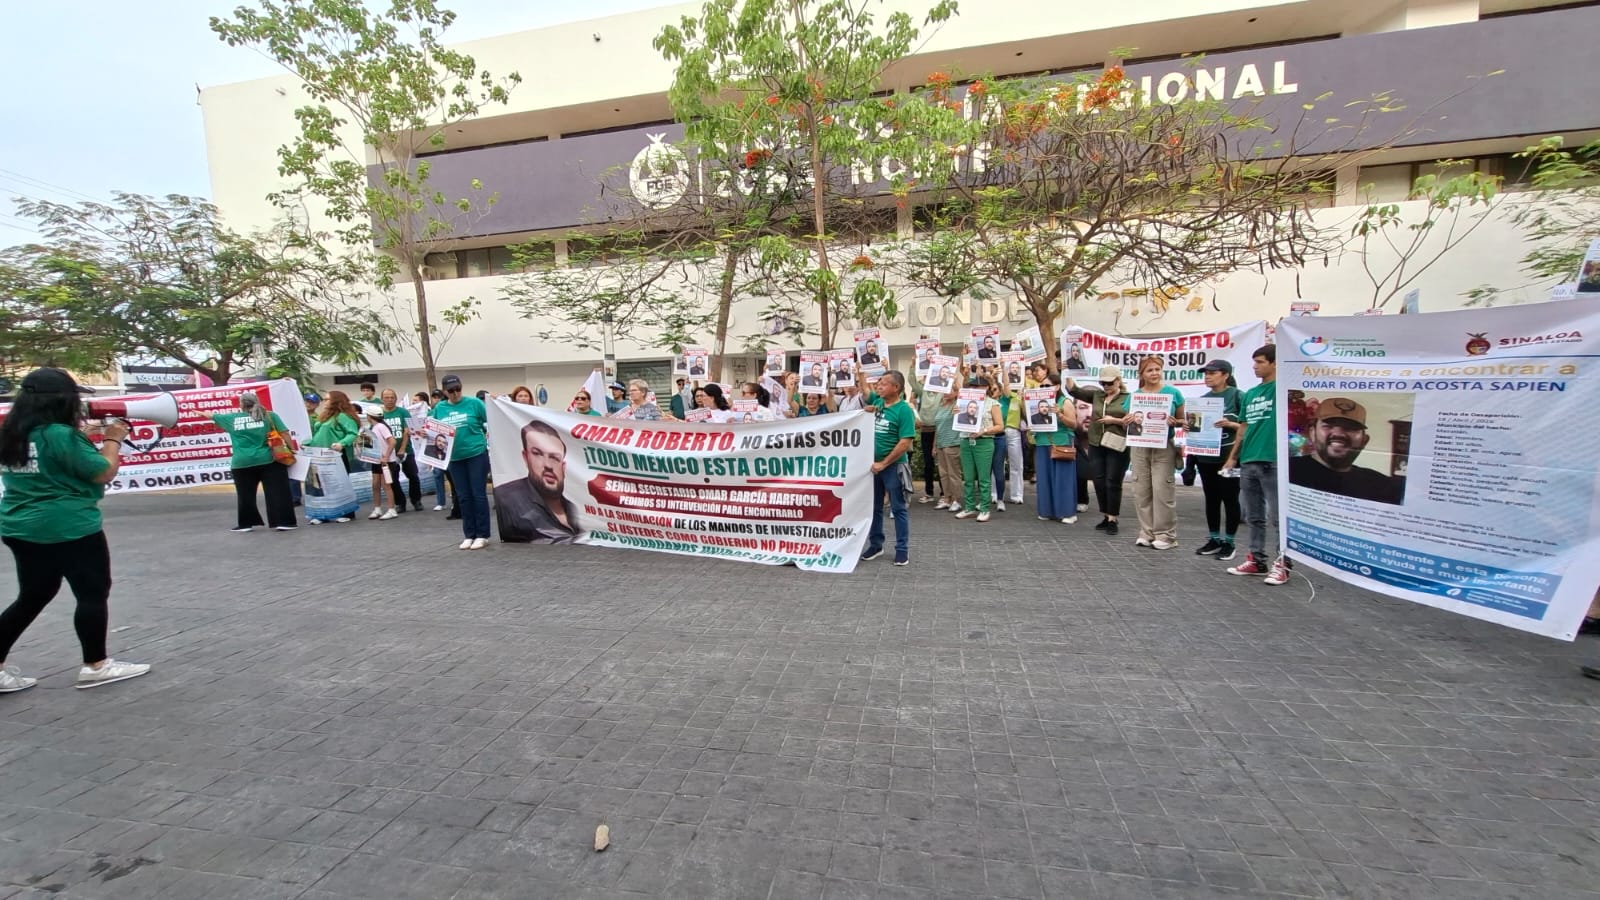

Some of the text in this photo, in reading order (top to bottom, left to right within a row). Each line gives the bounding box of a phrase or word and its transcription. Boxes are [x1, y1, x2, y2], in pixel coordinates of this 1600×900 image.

[1083, 332, 1131, 351] OMAR
[1136, 331, 1234, 352] ROBERTO,
[1499, 331, 1583, 346] SINALOA
[1102, 351, 1206, 367] NO SOLO
[1330, 347, 1386, 358] Sinaloa
[1179, 369, 1205, 381] CON
[1419, 363, 1549, 377] encontrar
[1560, 365, 1576, 375] a
[1302, 380, 1567, 392] OMAR ROBERTO ACOSTA SAPIEN
[180, 400, 233, 410] OR ERROR
[187, 393, 213, 401] HACE
[384, 417, 402, 426] MAR
[571, 424, 862, 453] OMAR ROBERTO, NO ESTAS SOLO
[170, 448, 228, 458] QUEREMOS
[198, 461, 231, 469] CORAZÓ
[583, 446, 630, 469] ¡TODO
[703, 457, 751, 477] ESTA
[754, 456, 847, 478] CONTIGO!
[128, 479, 140, 489] A
[144, 474, 197, 487] OMAR
[200, 470, 233, 482] ROB
[637, 484, 698, 498] SECRETARIO
[698, 490, 728, 501] OMAR
[619, 496, 654, 508] PEDIMOS
[655, 499, 666, 509] SU
[722, 503, 743, 514] PARA
[744, 507, 804, 519] ENCONTRARLO
[584, 504, 598, 515] NO
[604, 509, 615, 520] LA
[674, 518, 687, 530] DE
[688, 519, 707, 532] LOS
[708, 520, 754, 535] MANDOS
[755, 525, 768, 535] DE
[607, 522, 619, 533] SI
[619, 523, 665, 539] USTEDES
[665, 530, 699, 544] COMO
[700, 534, 758, 551] GOBIERNO
[760, 539, 776, 552] NO
[1365, 552, 1379, 562] Tu
[1380, 558, 1416, 572] ayuda
[1418, 566, 1436, 575] es
[1438, 570, 1470, 584] muy
[1380, 546, 1436, 565] referente
[1441, 561, 1451, 569] a
[1456, 563, 1489, 577] esta
